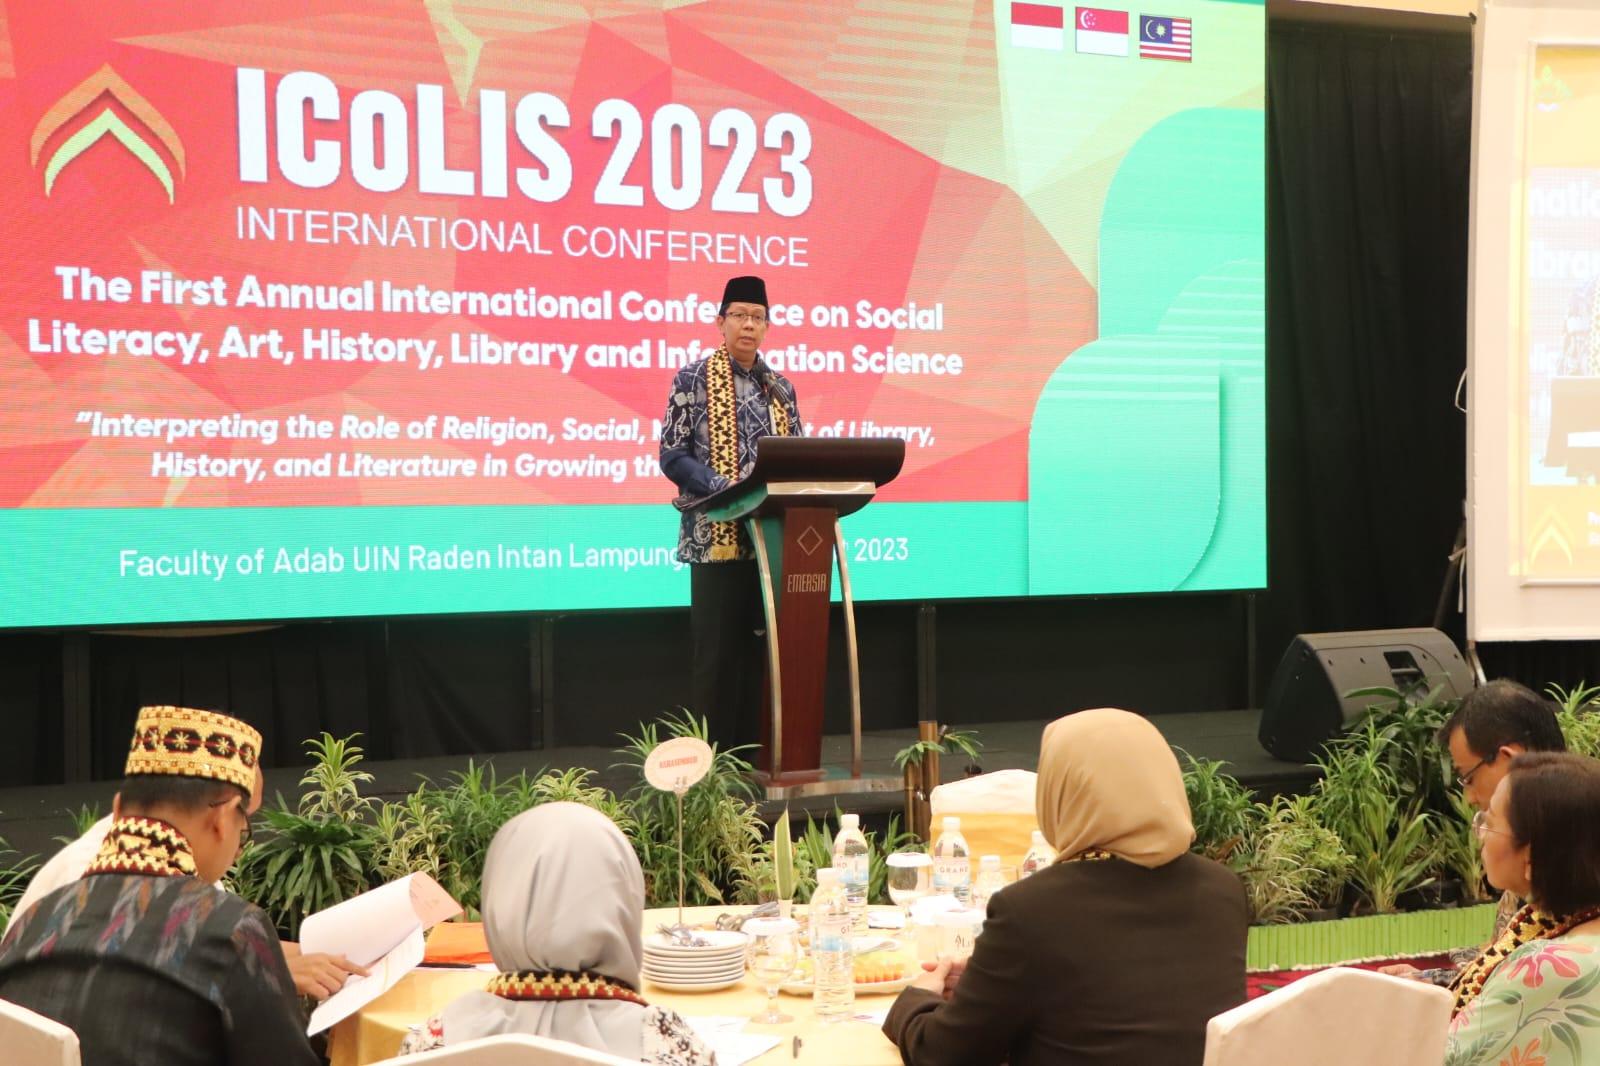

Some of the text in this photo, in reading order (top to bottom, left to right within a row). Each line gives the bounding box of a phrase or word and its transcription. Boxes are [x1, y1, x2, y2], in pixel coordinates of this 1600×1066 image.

[237, 67, 812, 217] ICoLIS 2023
[238, 205, 808, 267] INTERNATIONAL CONFERENCE
[55, 266, 944, 331] The First Annual International Confece on Social
[29, 319, 209, 365] Literacy,
[218, 326, 294, 365] Art,
[303, 328, 444, 370] History,
[451, 332, 579, 374] Library
[585, 339, 651, 369] and
[852, 344, 964, 376] Science
[285, 414, 334, 439] the
[339, 414, 401, 440] Role
[406, 414, 438, 440] of
[441, 415, 555, 447] Religion,
[562, 417, 645, 445] Social,
[818, 420, 844, 438] of
[151, 451, 661, 484] History, and Literature in Growing th
[119, 549, 229, 581] Faculty
[235, 547, 265, 575] of
[273, 546, 345, 574] Adab
[353, 545, 400, 572] UIN
[408, 544, 491, 571] Raden
[497, 543, 563, 569] Intan
[854, 537, 909, 562] 2023
[787, 573, 827, 593] EMERSIA
